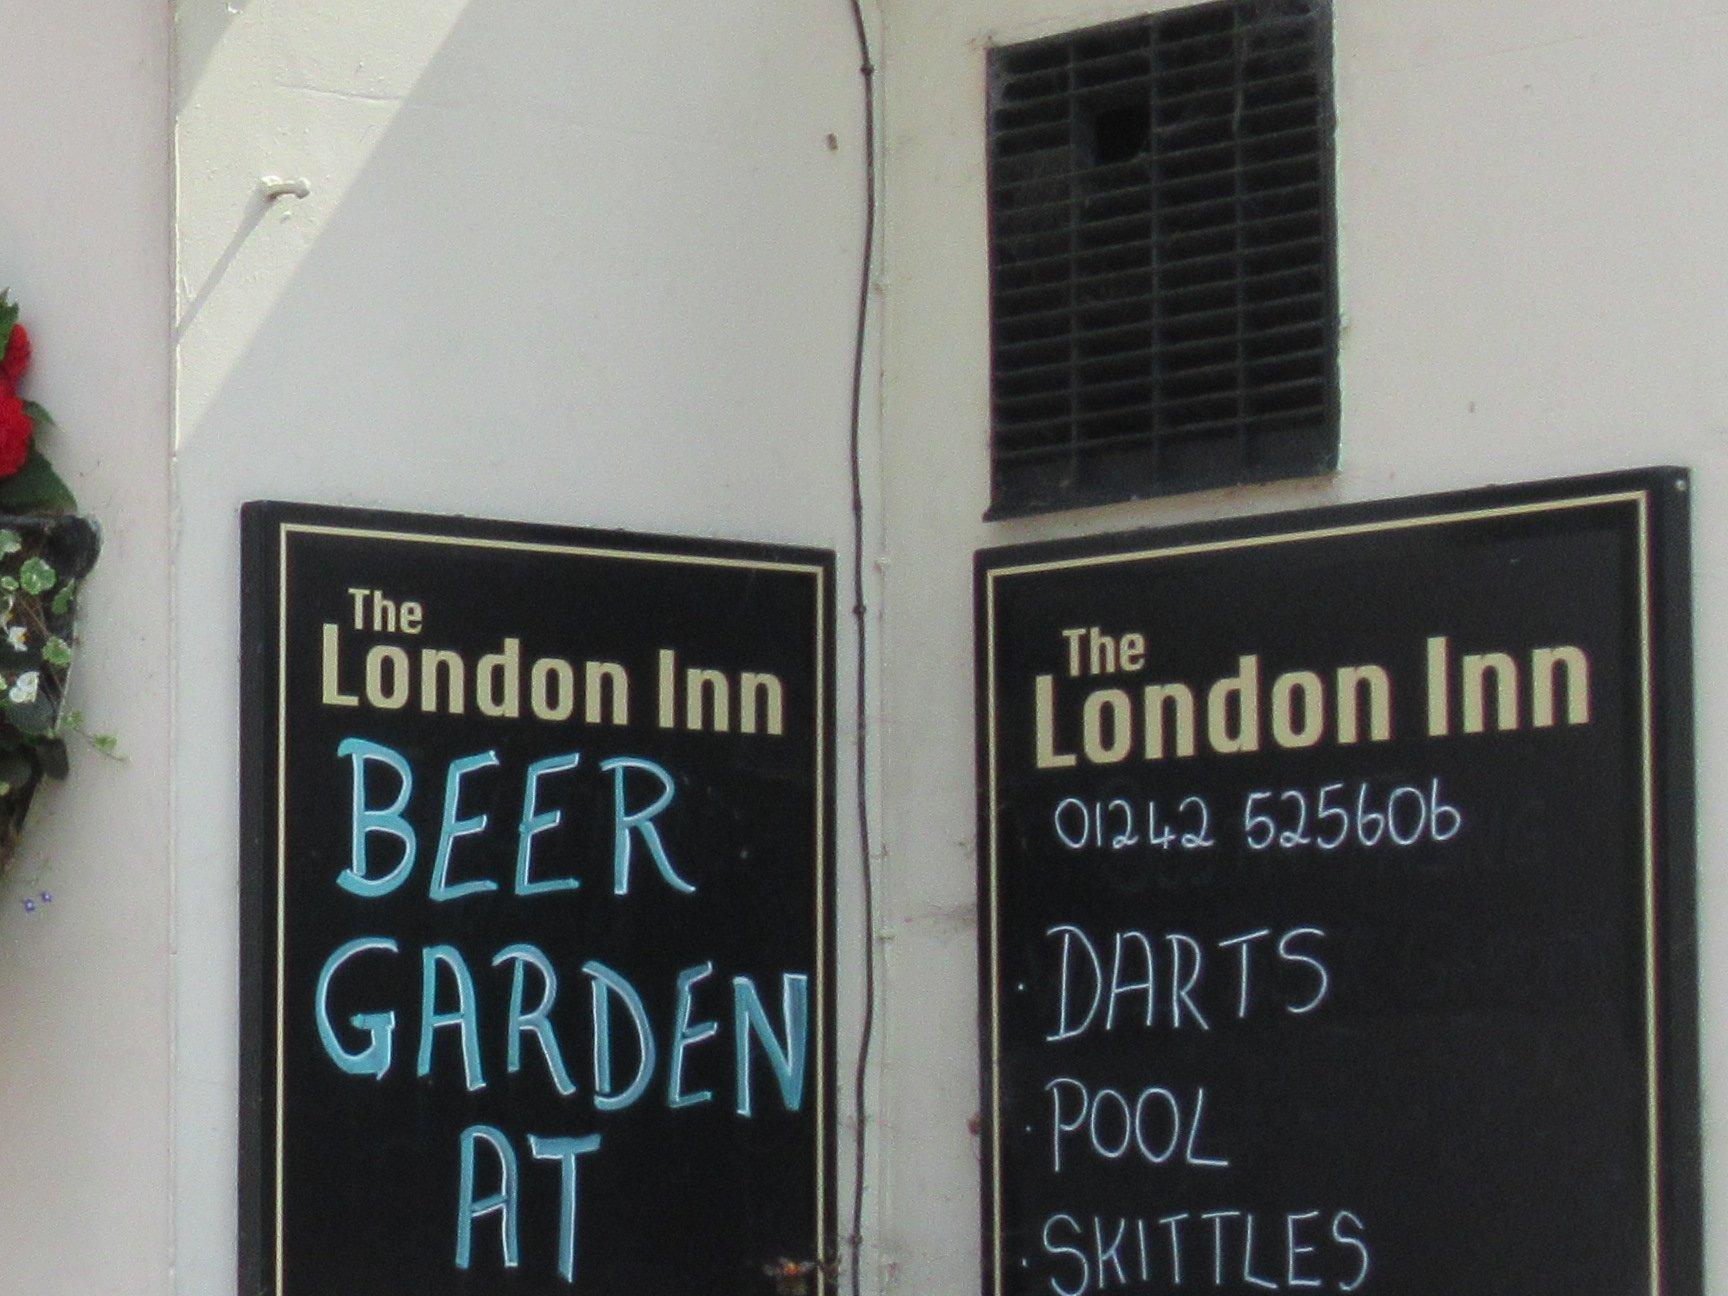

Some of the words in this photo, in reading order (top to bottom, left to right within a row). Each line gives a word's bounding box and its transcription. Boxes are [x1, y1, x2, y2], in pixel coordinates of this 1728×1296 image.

[348, 587, 424, 636] The
[1062, 626, 1145, 677] The
[320, 623, 630, 727] London
[658, 649, 784, 736] Inn
[1035, 654, 1391, 769] London
[1426, 635, 1591, 737] Inn
[336, 737, 696, 902] BEER
[1054, 796, 1215, 850] 01242
[1243, 777, 1462, 850] 525606
[314, 936, 808, 1117] GARDEN
[1045, 924, 1331, 1042] DARTS
[1045, 1078, 1229, 1172] POOL
[454, 1123, 602, 1283] AT
